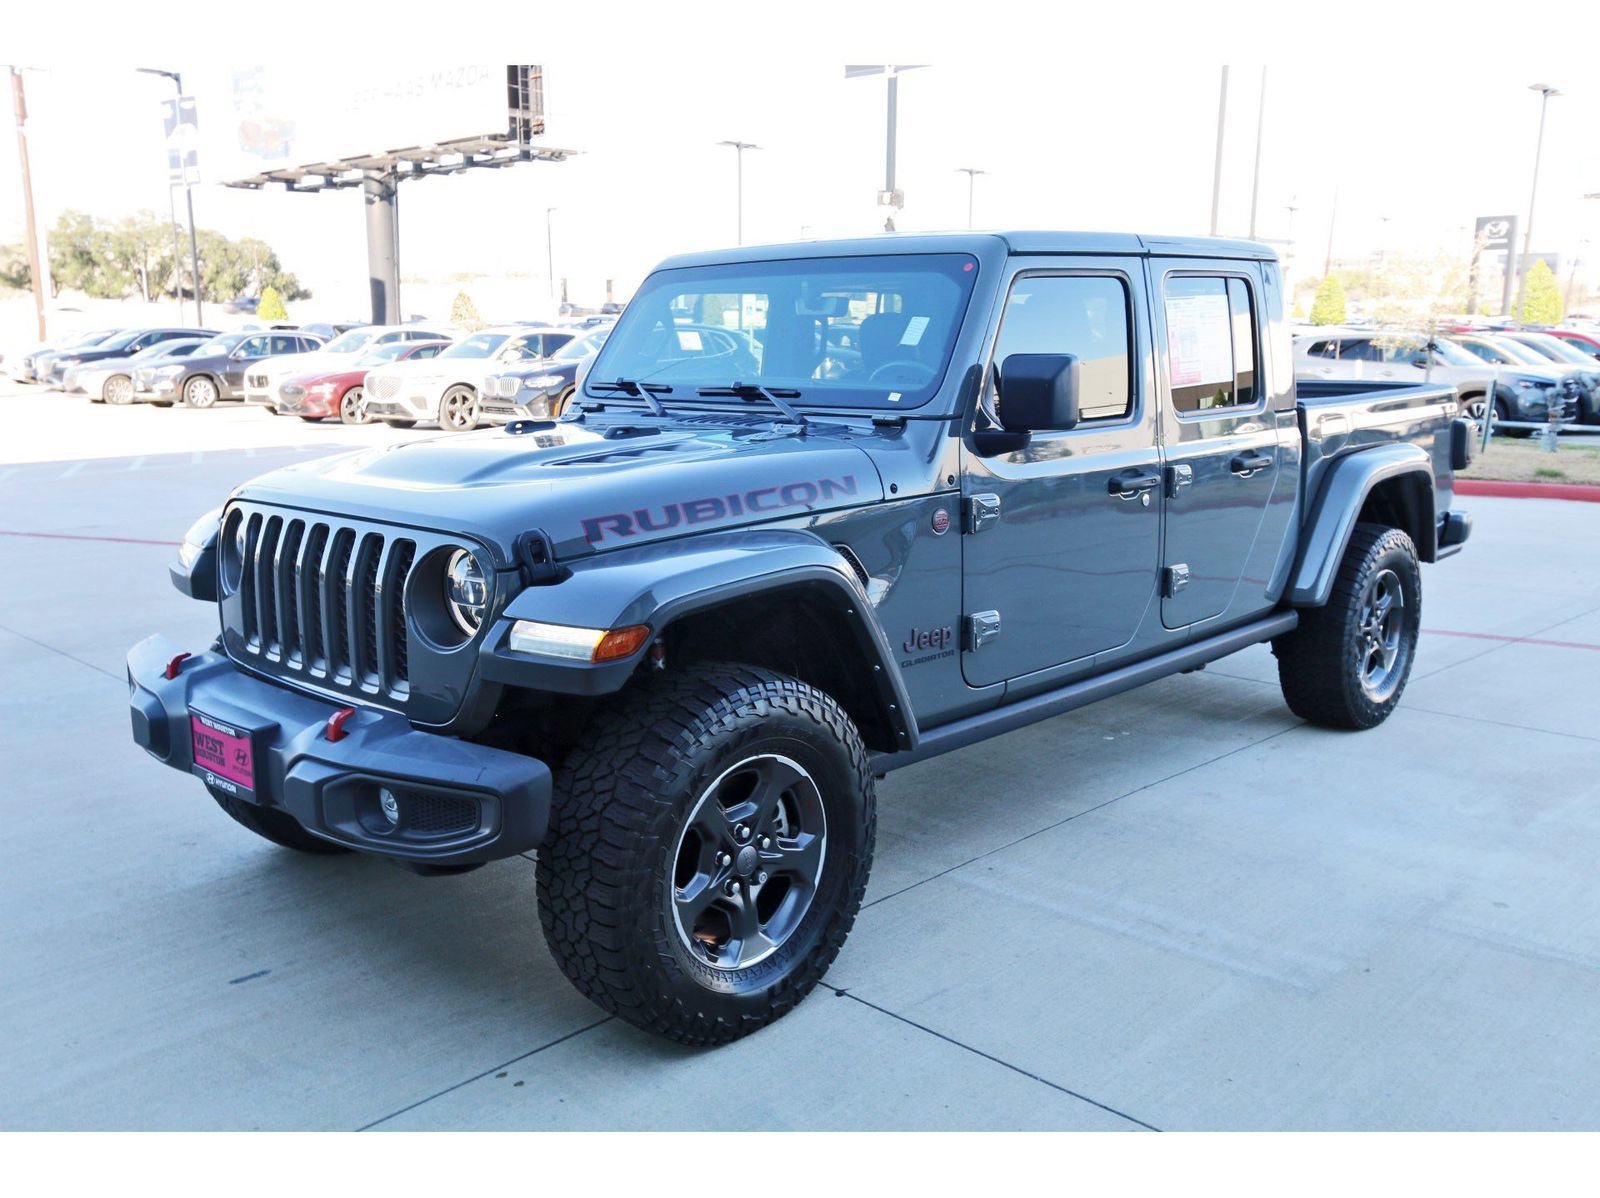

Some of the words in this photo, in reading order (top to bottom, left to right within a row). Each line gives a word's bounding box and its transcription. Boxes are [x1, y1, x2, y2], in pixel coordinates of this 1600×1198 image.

[580, 475, 857, 544] RUBICON
[903, 626, 951, 653] Jeep
[901, 649, 954, 668] GLADIATOR
[194, 731, 224, 756] WEST
[215, 778, 237, 794] HYUNDAI
